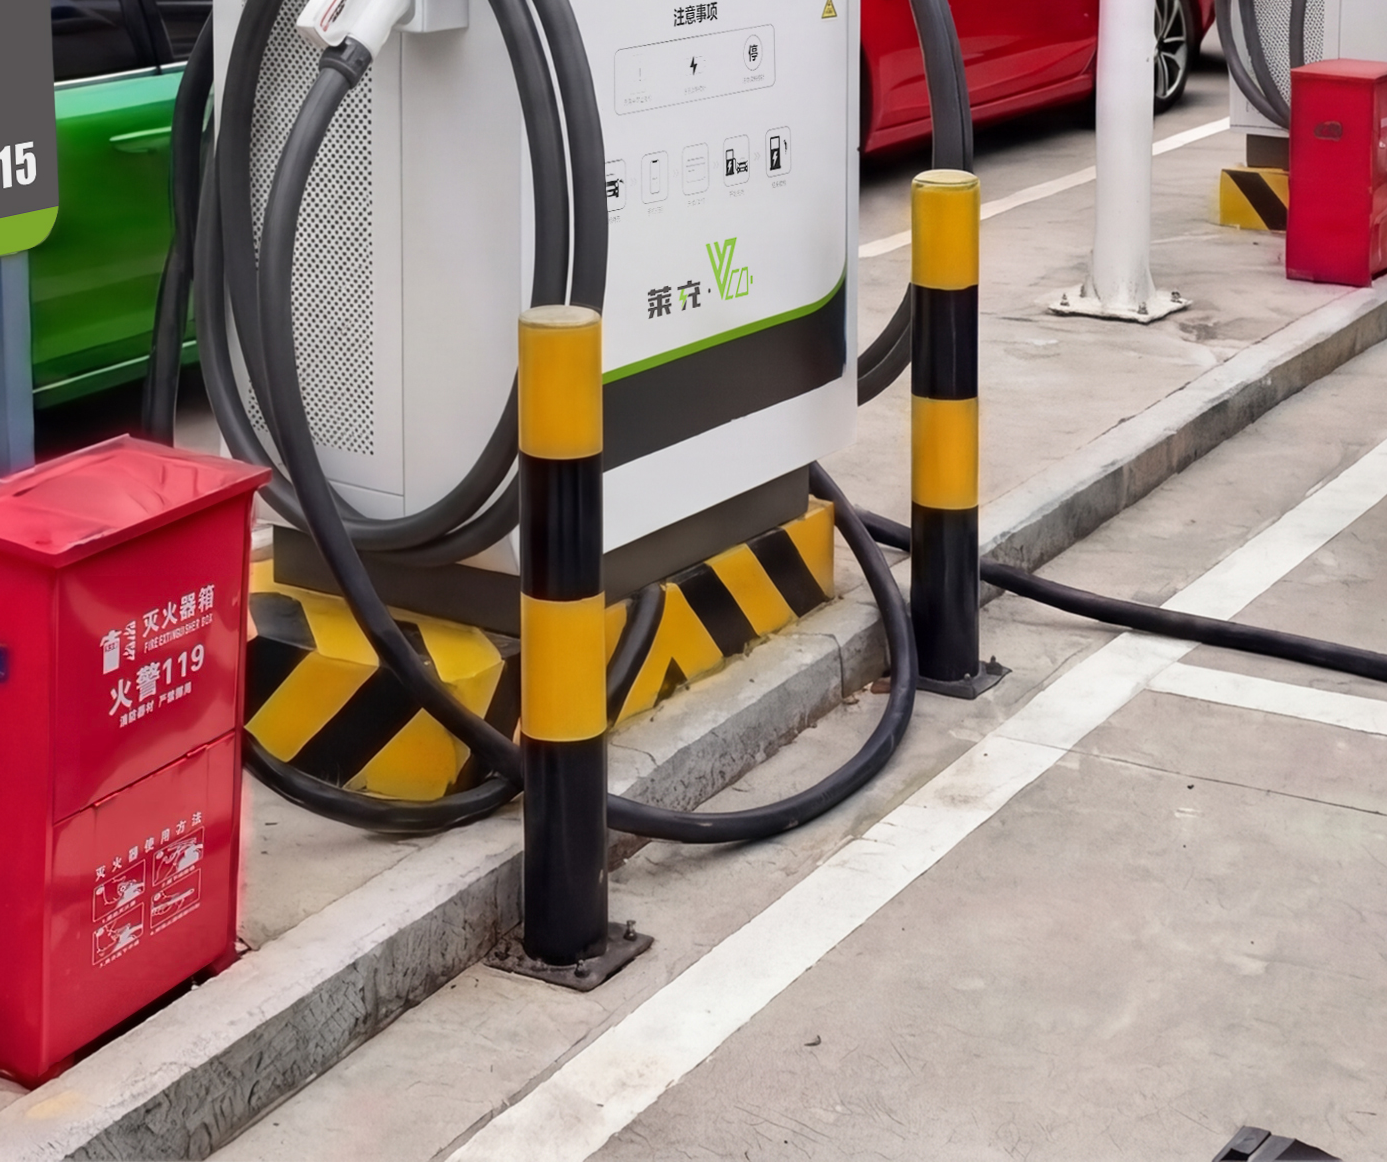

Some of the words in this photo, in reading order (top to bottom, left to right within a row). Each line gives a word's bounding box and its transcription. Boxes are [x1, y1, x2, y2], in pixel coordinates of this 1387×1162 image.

[673, 1, 718, 27] 注意事项
[142, 584, 215, 638] 灭火器箱
[109, 644, 205, 716] 火警119
